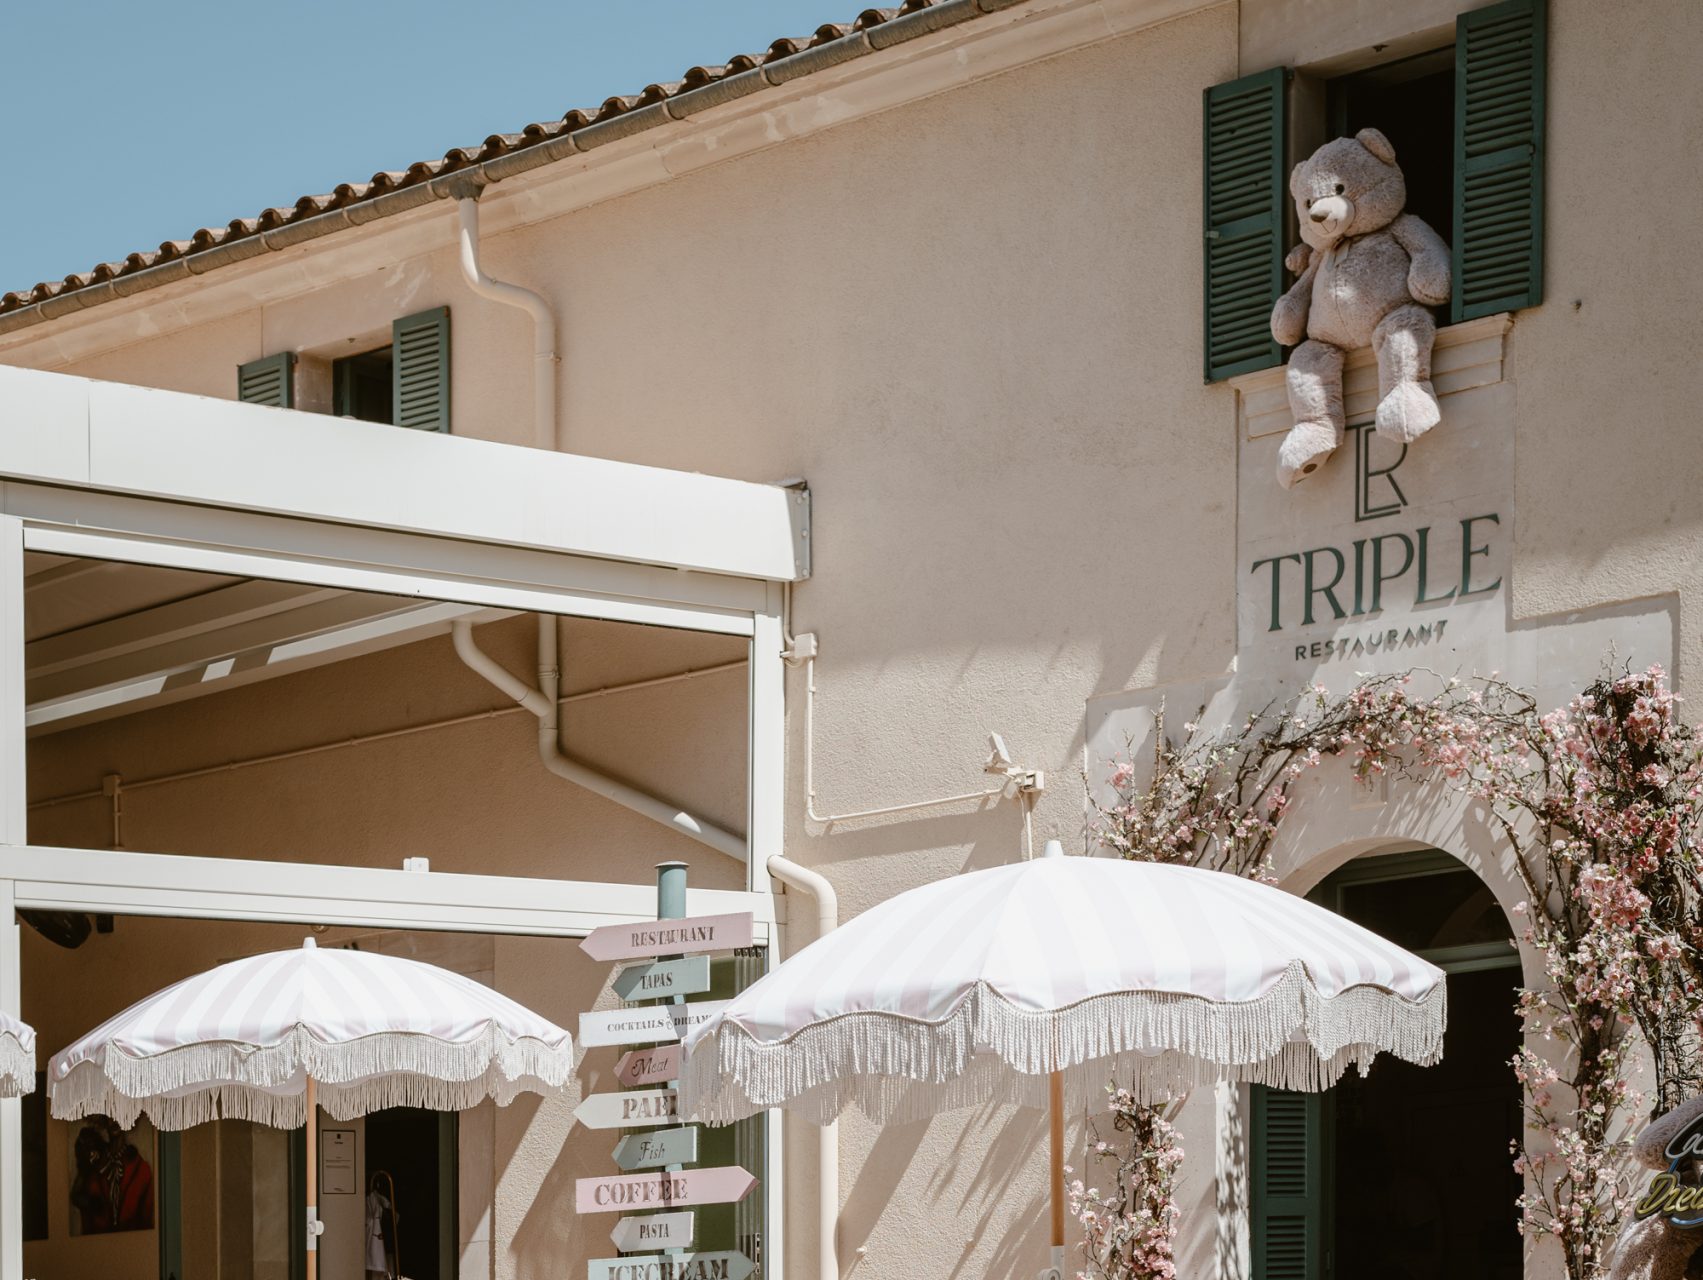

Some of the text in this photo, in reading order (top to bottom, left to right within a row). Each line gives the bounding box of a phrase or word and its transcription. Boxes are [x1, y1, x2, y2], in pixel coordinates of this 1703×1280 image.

[1250, 513, 1503, 632] TRIPLE
[1295, 619, 1448, 661] RESTAURANT
[631, 926, 715, 948] RESTAURANT
[640, 972, 673, 990] TAPAS
[607, 1019, 664, 1032] COCKTAILS
[631, 1057, 669, 1078] Meat
[638, 1141, 666, 1162] Fish
[594, 1178, 688, 1206] COFFEE
[639, 1223, 670, 1239] PASTA
